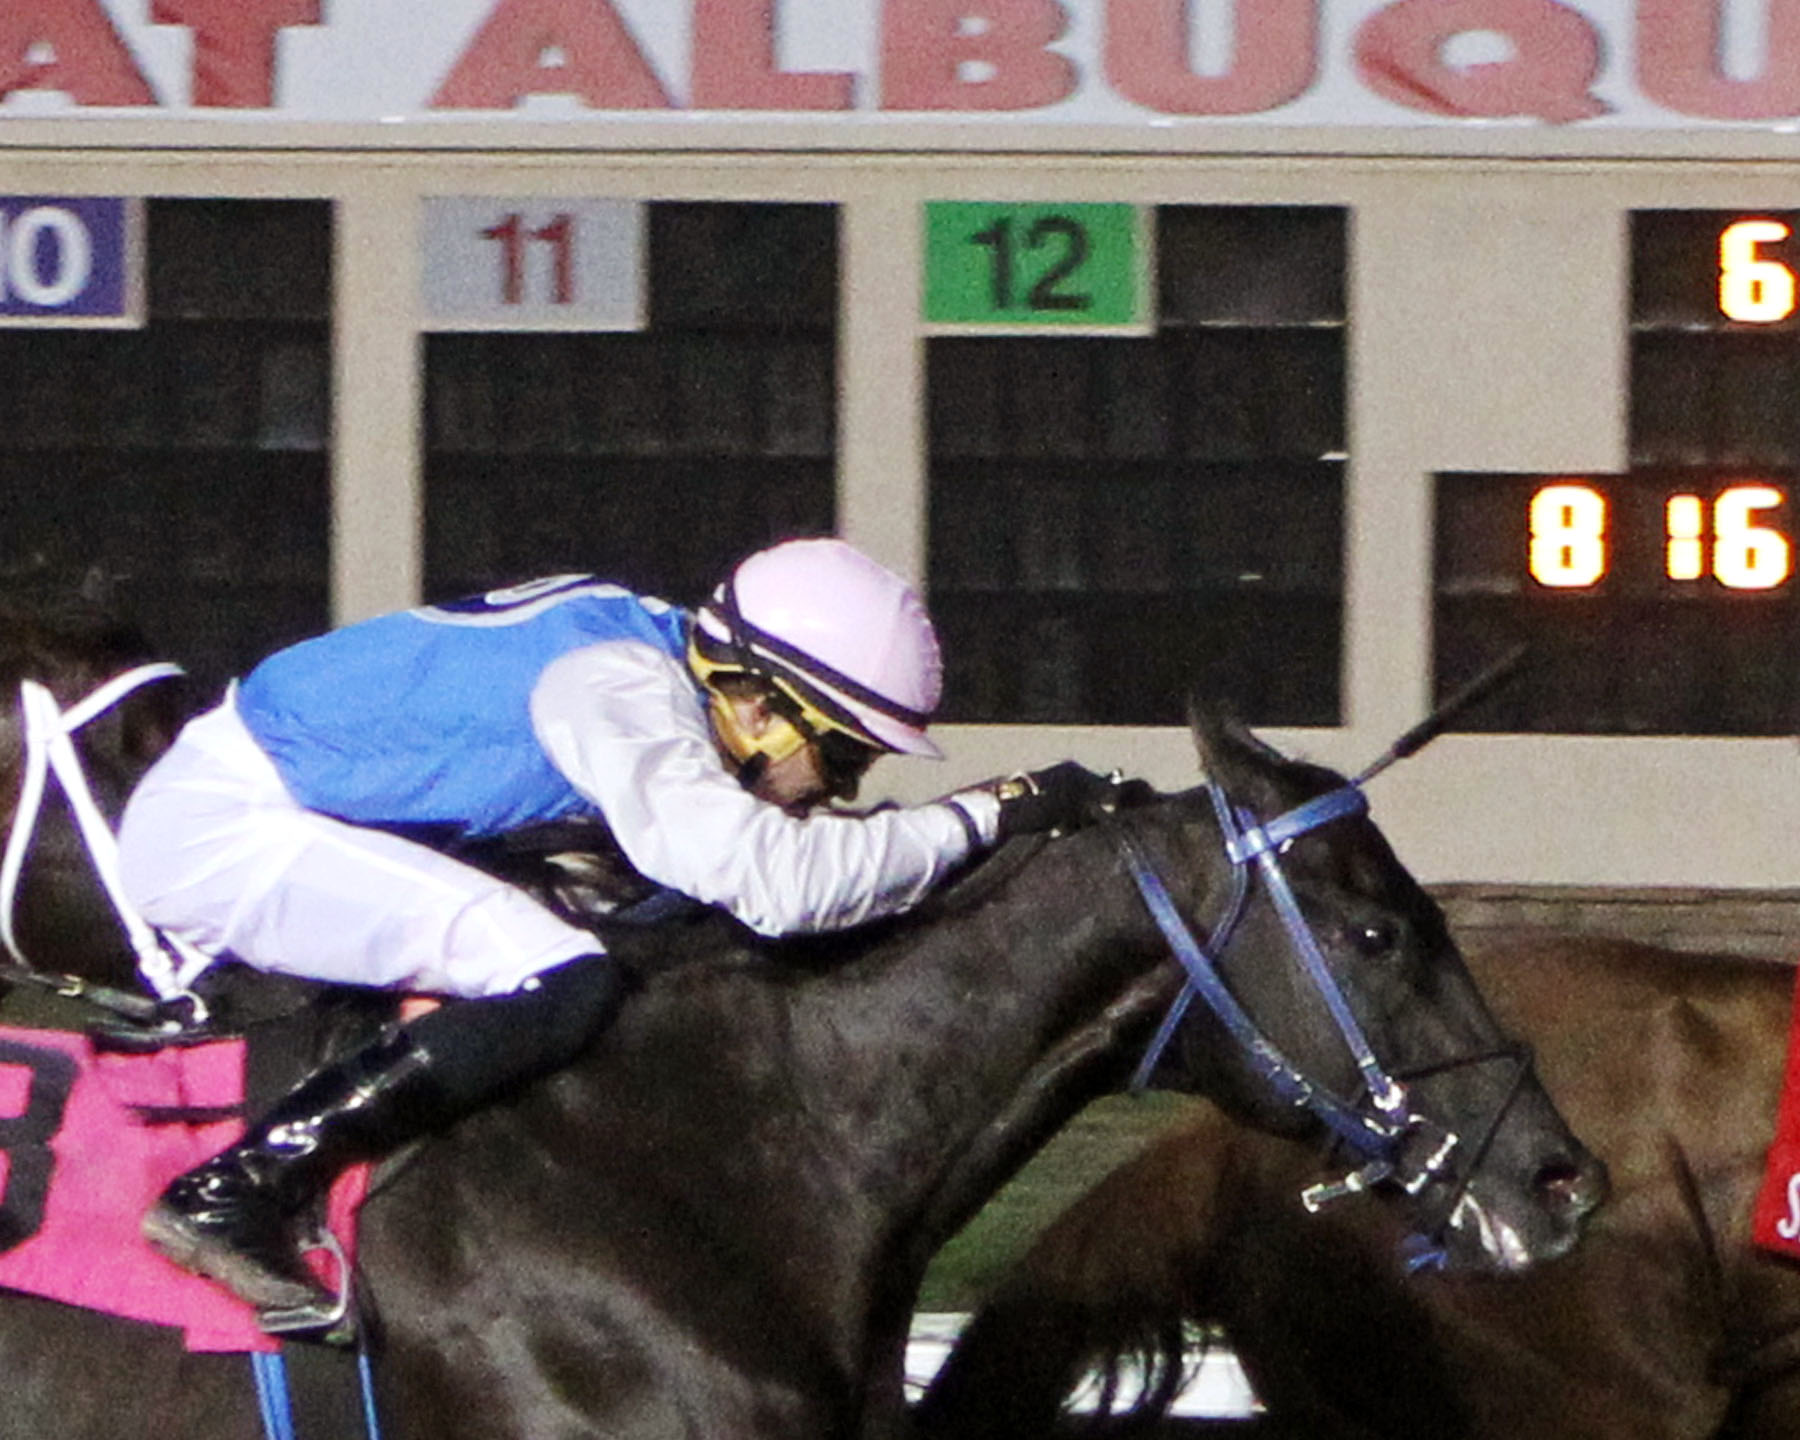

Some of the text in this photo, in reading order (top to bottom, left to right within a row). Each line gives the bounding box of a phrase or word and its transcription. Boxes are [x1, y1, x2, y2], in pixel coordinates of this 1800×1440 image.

[0, 0, 323, 107] AT
[0, 205, 92, 306] 0
[479, 212, 577, 306] 11
[969, 215, 1094, 312] 12
[1718, 219, 1796, 324] 6
[1528, 484, 1792, 591] 8 16
